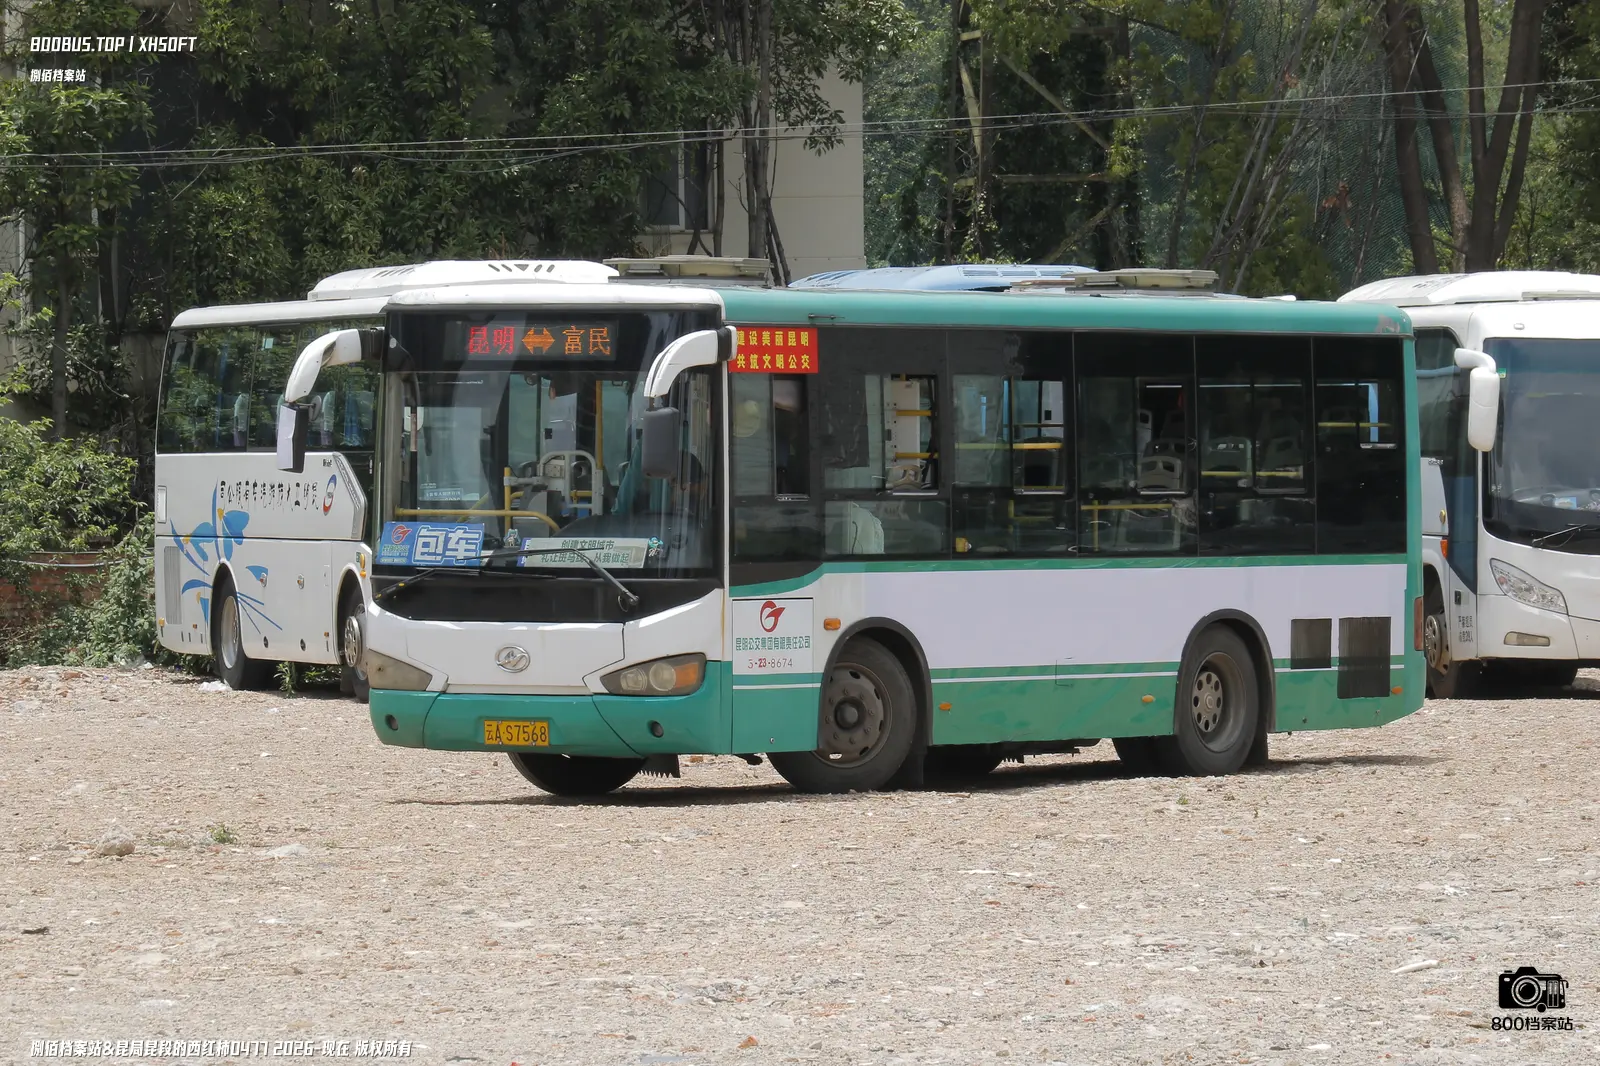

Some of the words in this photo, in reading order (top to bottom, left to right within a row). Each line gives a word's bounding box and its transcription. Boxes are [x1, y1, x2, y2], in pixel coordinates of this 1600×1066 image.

[468, 326, 516, 355] 昆明
[562, 325, 611, 355] 富民
[736, 330, 810, 347] 建设美丽昆明
[736, 354, 811, 370] 共筑文明公交
[413, 526, 482, 563] 包车
[561, 539, 615, 551] 创建文明城市
[735, 635, 811, 651] 昆明公交集团有限责任公司
